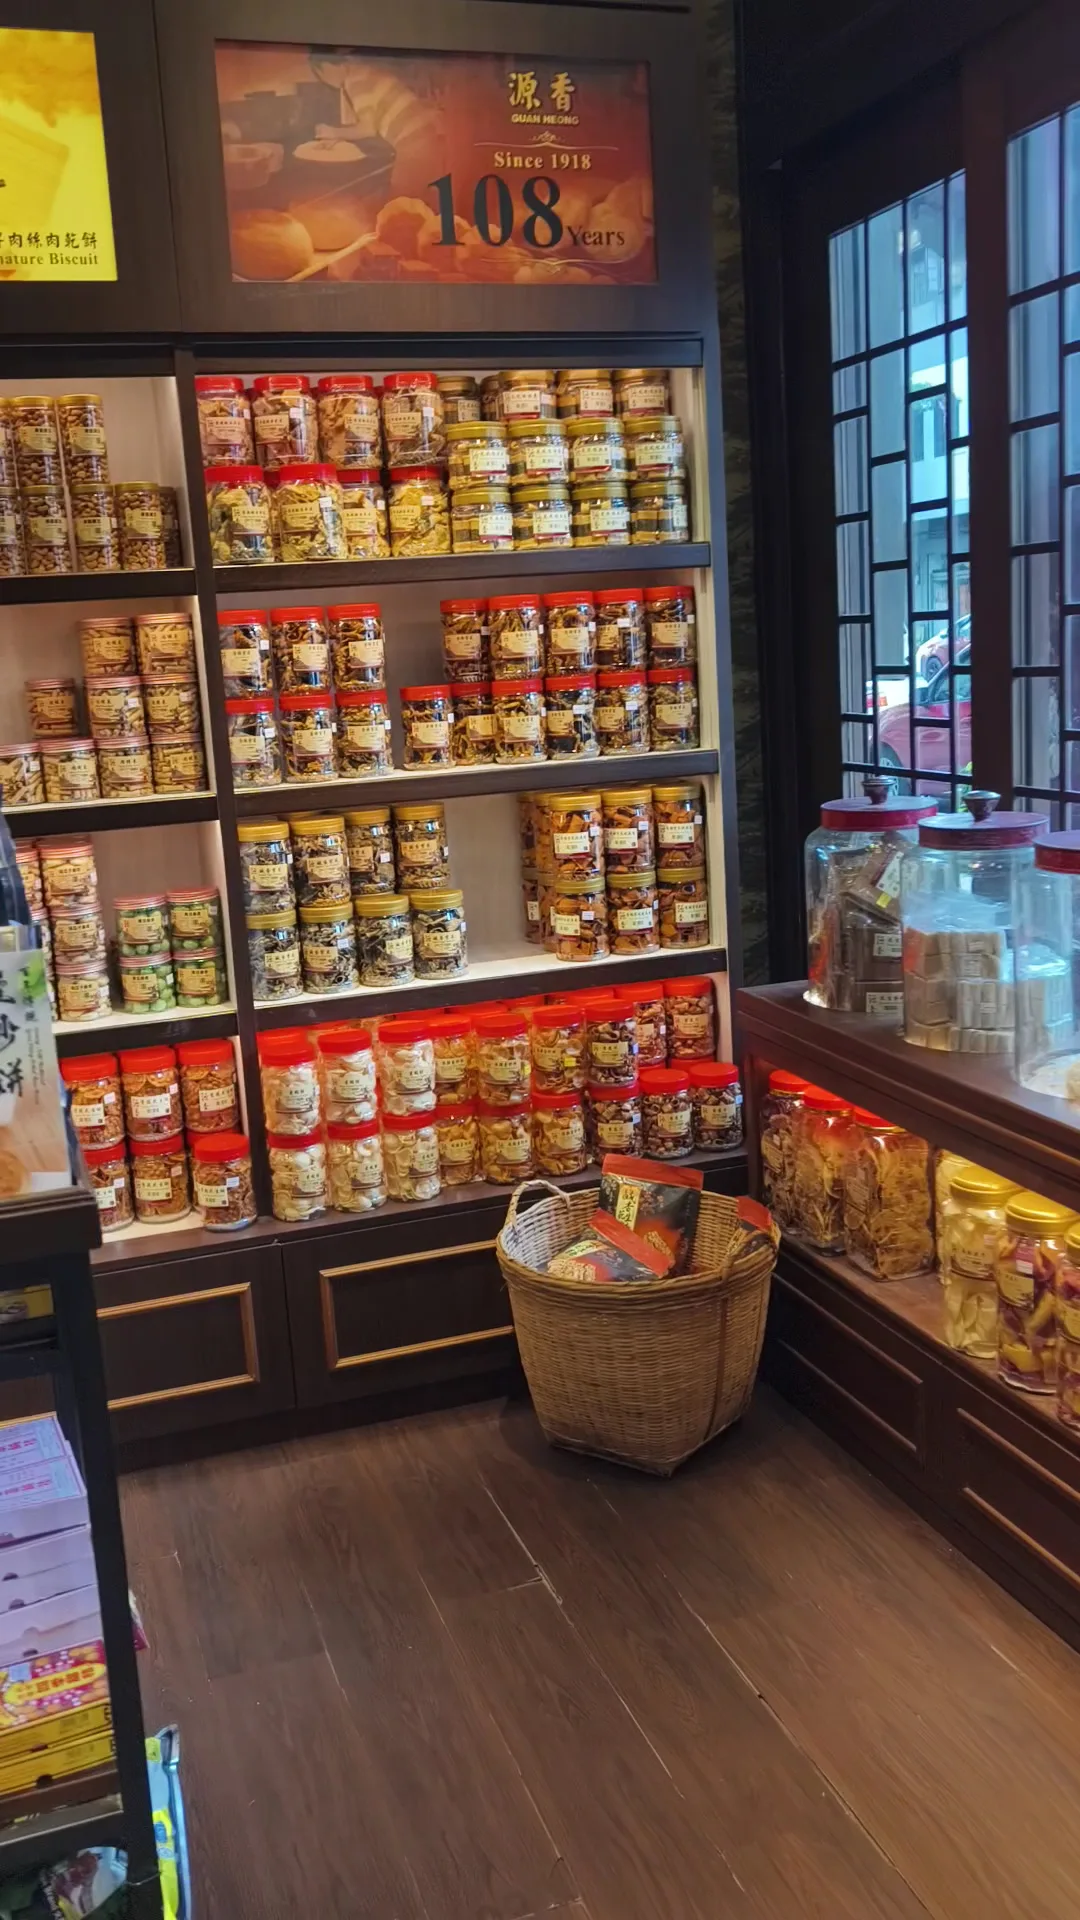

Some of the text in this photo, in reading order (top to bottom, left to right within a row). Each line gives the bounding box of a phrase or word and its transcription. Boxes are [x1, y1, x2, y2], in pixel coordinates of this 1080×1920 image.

[508, 71, 575, 112] 源香
[511, 113, 580, 125] GUAN HEONG
[493, 151, 592, 170] Since 1918
[427, 172, 625, 249] 108 Years
[49, 252, 98, 265] Biscuit
